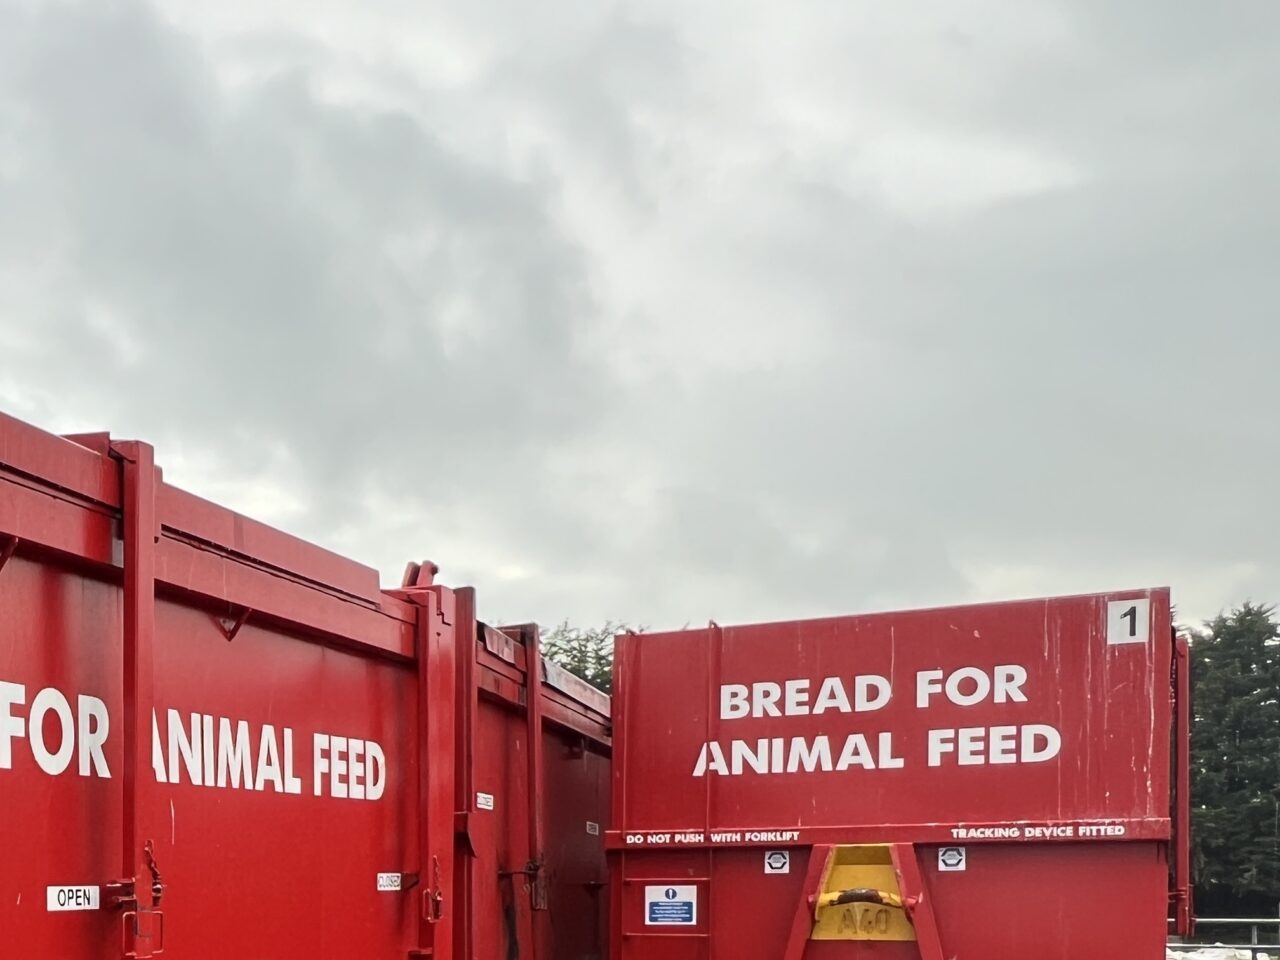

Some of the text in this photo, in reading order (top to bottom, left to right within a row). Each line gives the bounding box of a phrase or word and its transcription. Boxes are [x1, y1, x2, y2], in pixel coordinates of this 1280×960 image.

[1121, 606, 1137, 637] 1
[720, 664, 1028, 720] BREAD FOR
[692, 724, 1062, 777] ANIMAL FEED
[313, 732, 386, 801] FEED
[626, 831, 800, 844] DO NOT PUSH WITH FORKLIFT
[951, 825, 1125, 838] TRACKING DEVICE FITTED
[57, 888, 91, 907] OPEN
